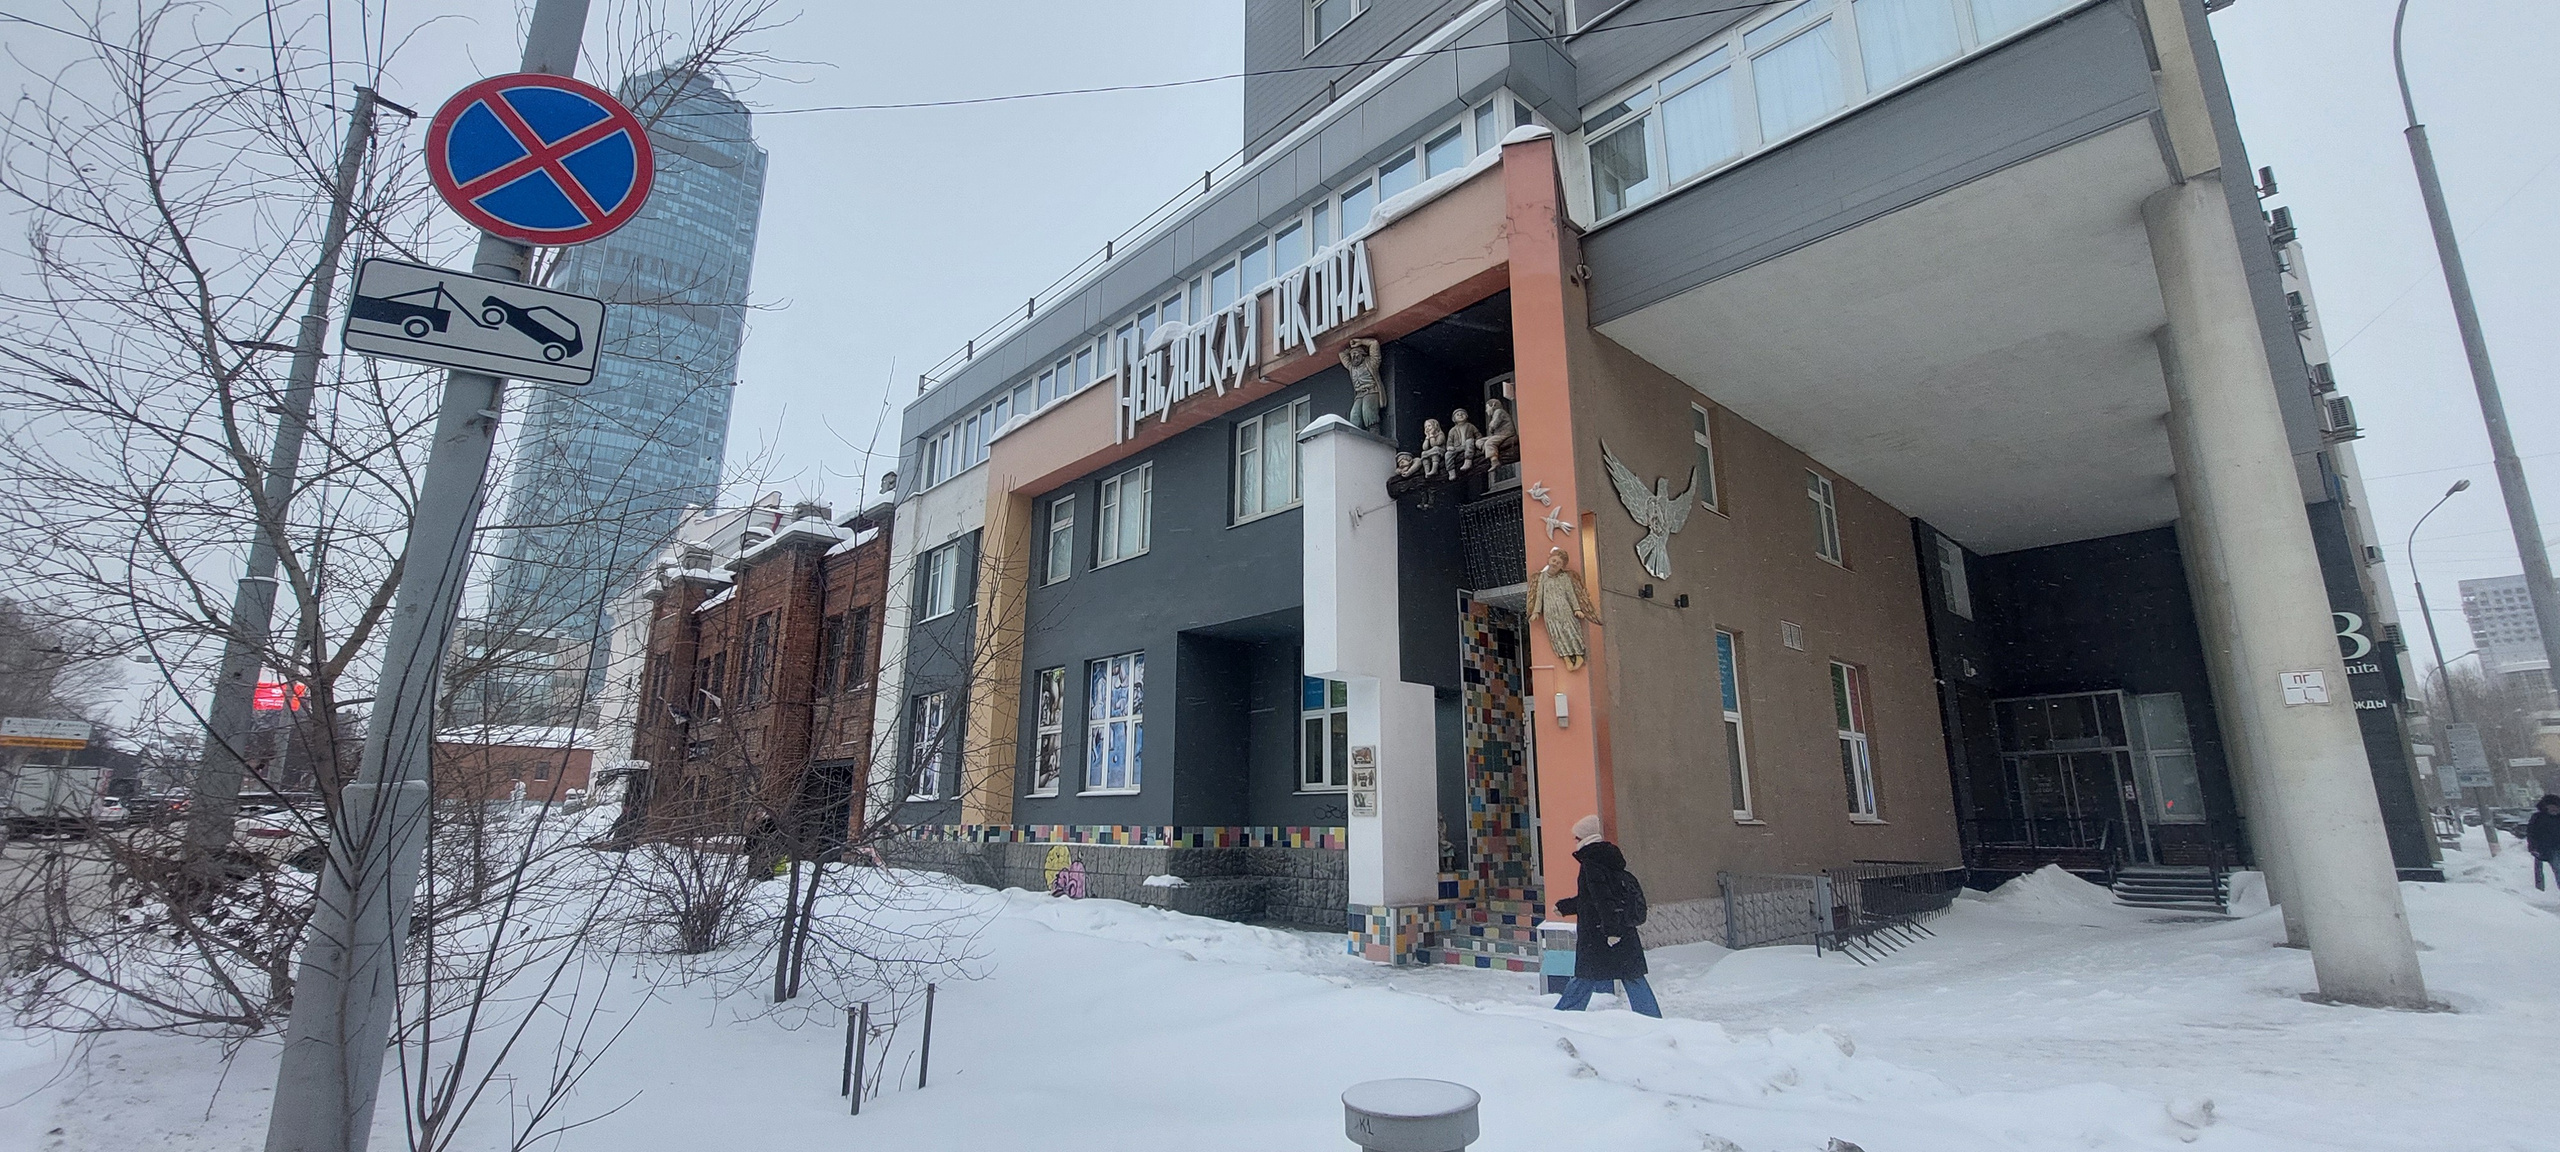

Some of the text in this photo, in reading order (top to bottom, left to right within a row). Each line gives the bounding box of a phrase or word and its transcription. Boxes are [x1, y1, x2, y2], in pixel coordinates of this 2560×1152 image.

[2345, 661, 2380, 675] nita
[2293, 674, 2311, 685] ПГ
[2354, 699, 2387, 710] жды
